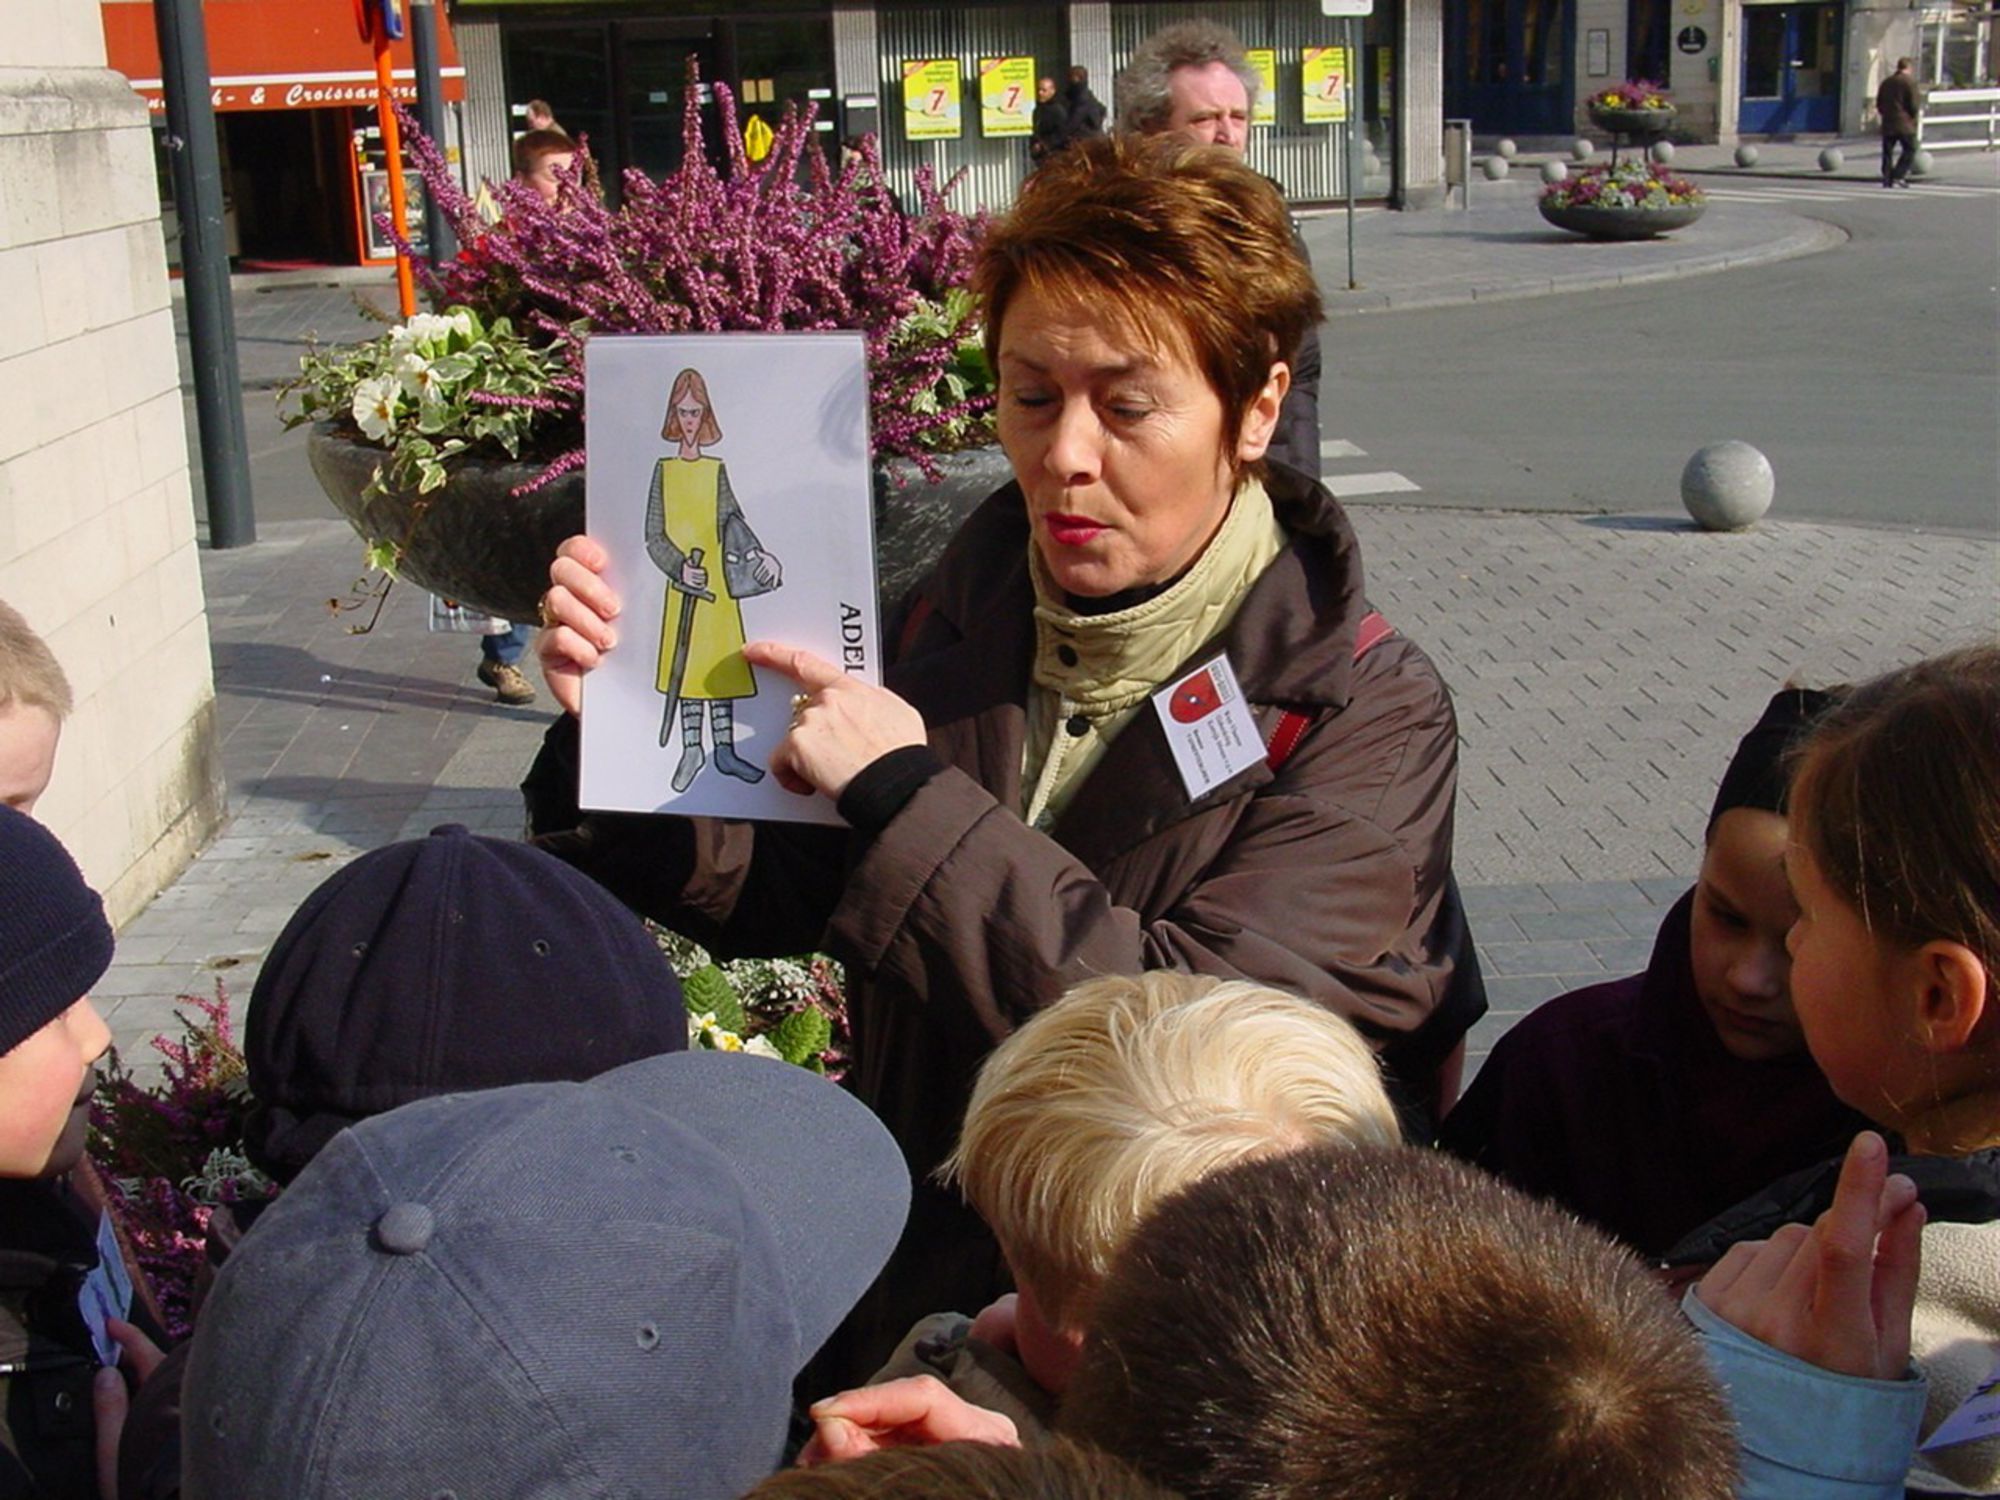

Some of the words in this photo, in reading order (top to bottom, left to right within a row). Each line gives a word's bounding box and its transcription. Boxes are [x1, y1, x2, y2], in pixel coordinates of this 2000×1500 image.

[250, 86, 266, 105] &
[1327, 75, 1340, 96] 7
[931, 89, 945, 112] 7
[1007, 86, 1021, 109] 7
